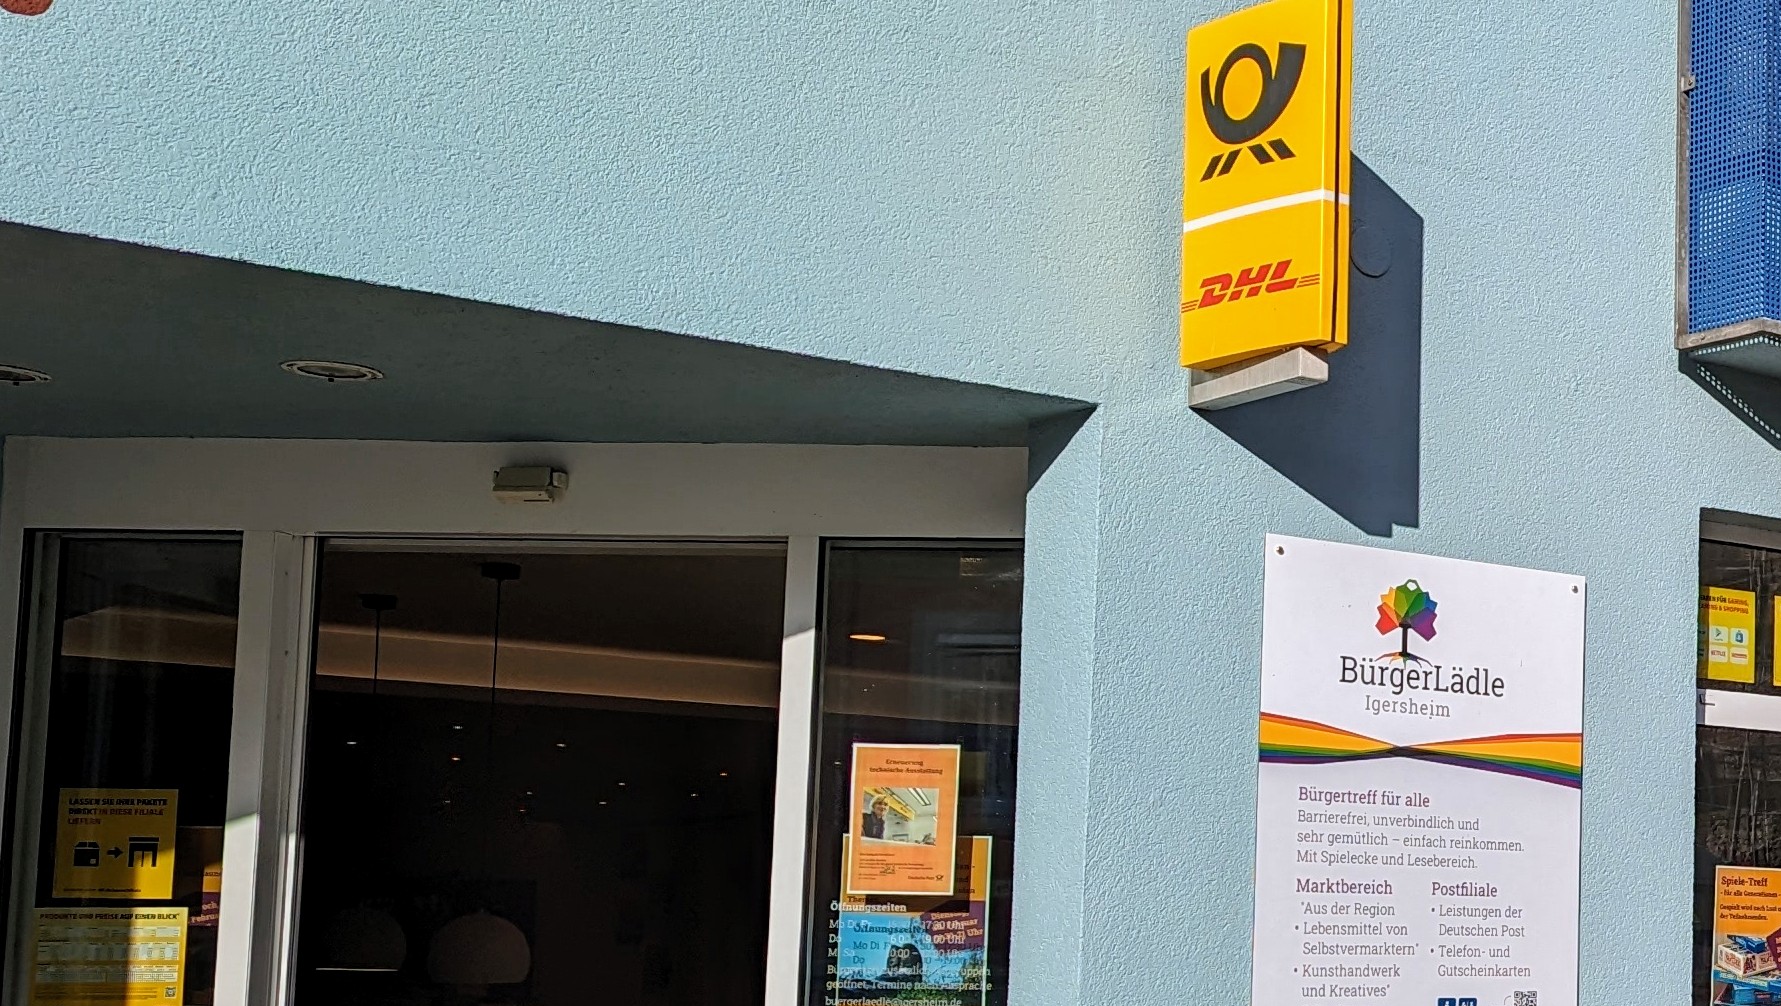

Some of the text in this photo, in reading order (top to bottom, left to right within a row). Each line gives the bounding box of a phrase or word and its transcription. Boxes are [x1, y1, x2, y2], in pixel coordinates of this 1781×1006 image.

[1197, 259, 1299, 310] DHL
[1339, 655, 1505, 697] BürgerLädle
[1365, 695, 1450, 718] Igersheim
[1298, 786, 1430, 807] Bürgertreff für alle
[1298, 809, 1480, 831] Barrierefrei, unverbindlich und
[1297, 829, 1525, 852] sehr gemütlich einfach reinkommen.
[1297, 849, 1478, 869] Mit Spielecke und Lesebereich.
[1296, 878, 1393, 895] Marktbereich
[1431, 881, 1498, 898] Postfiliale
[1720, 876, 1768, 887] Spiele-Treff
[830, 900, 907, 913] Öffnungszeiten
[1330, 901, 1351, 915] der
[1354, 902, 1395, 919] Region
[1439, 904, 1523, 920] Leistungen der
[1303, 921, 1408, 936] Lebensmittel von
[1438, 923, 1525, 938] Deutschen Post
[1438, 944, 1511, 958] Telefon- und
[1302, 964, 1400, 977] Kunsthandwerk
[1437, 963, 1531, 977] Gutscheinkarten
[1301, 983, 1326, 998] und
